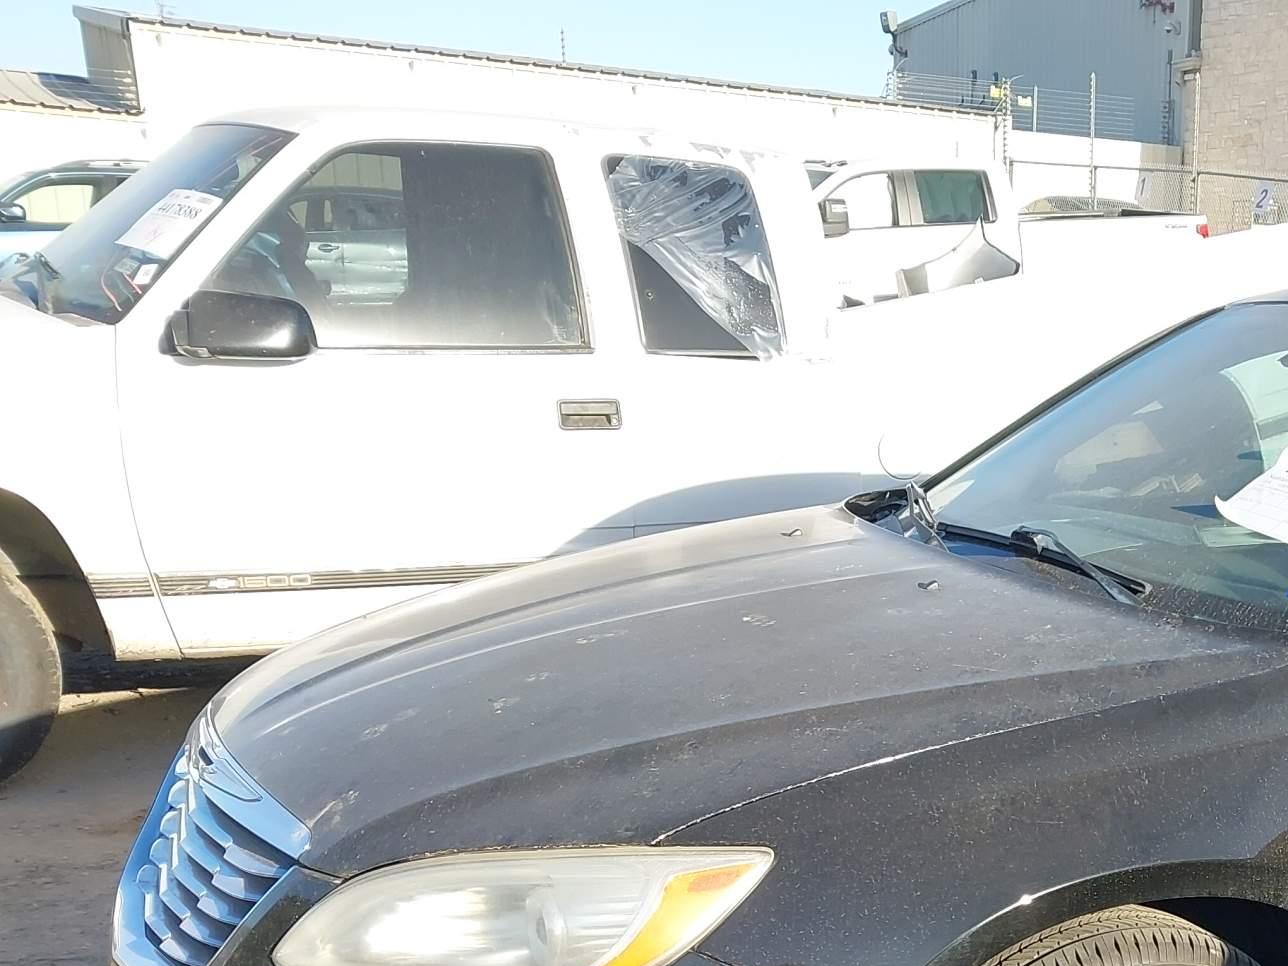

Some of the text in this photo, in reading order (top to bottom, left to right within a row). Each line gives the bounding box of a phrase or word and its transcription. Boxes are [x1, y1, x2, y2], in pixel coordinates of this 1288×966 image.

[1139, 176, 1147, 197] 1
[1255, 188, 1269, 209] 2
[237, 574, 312, 588] 1500
